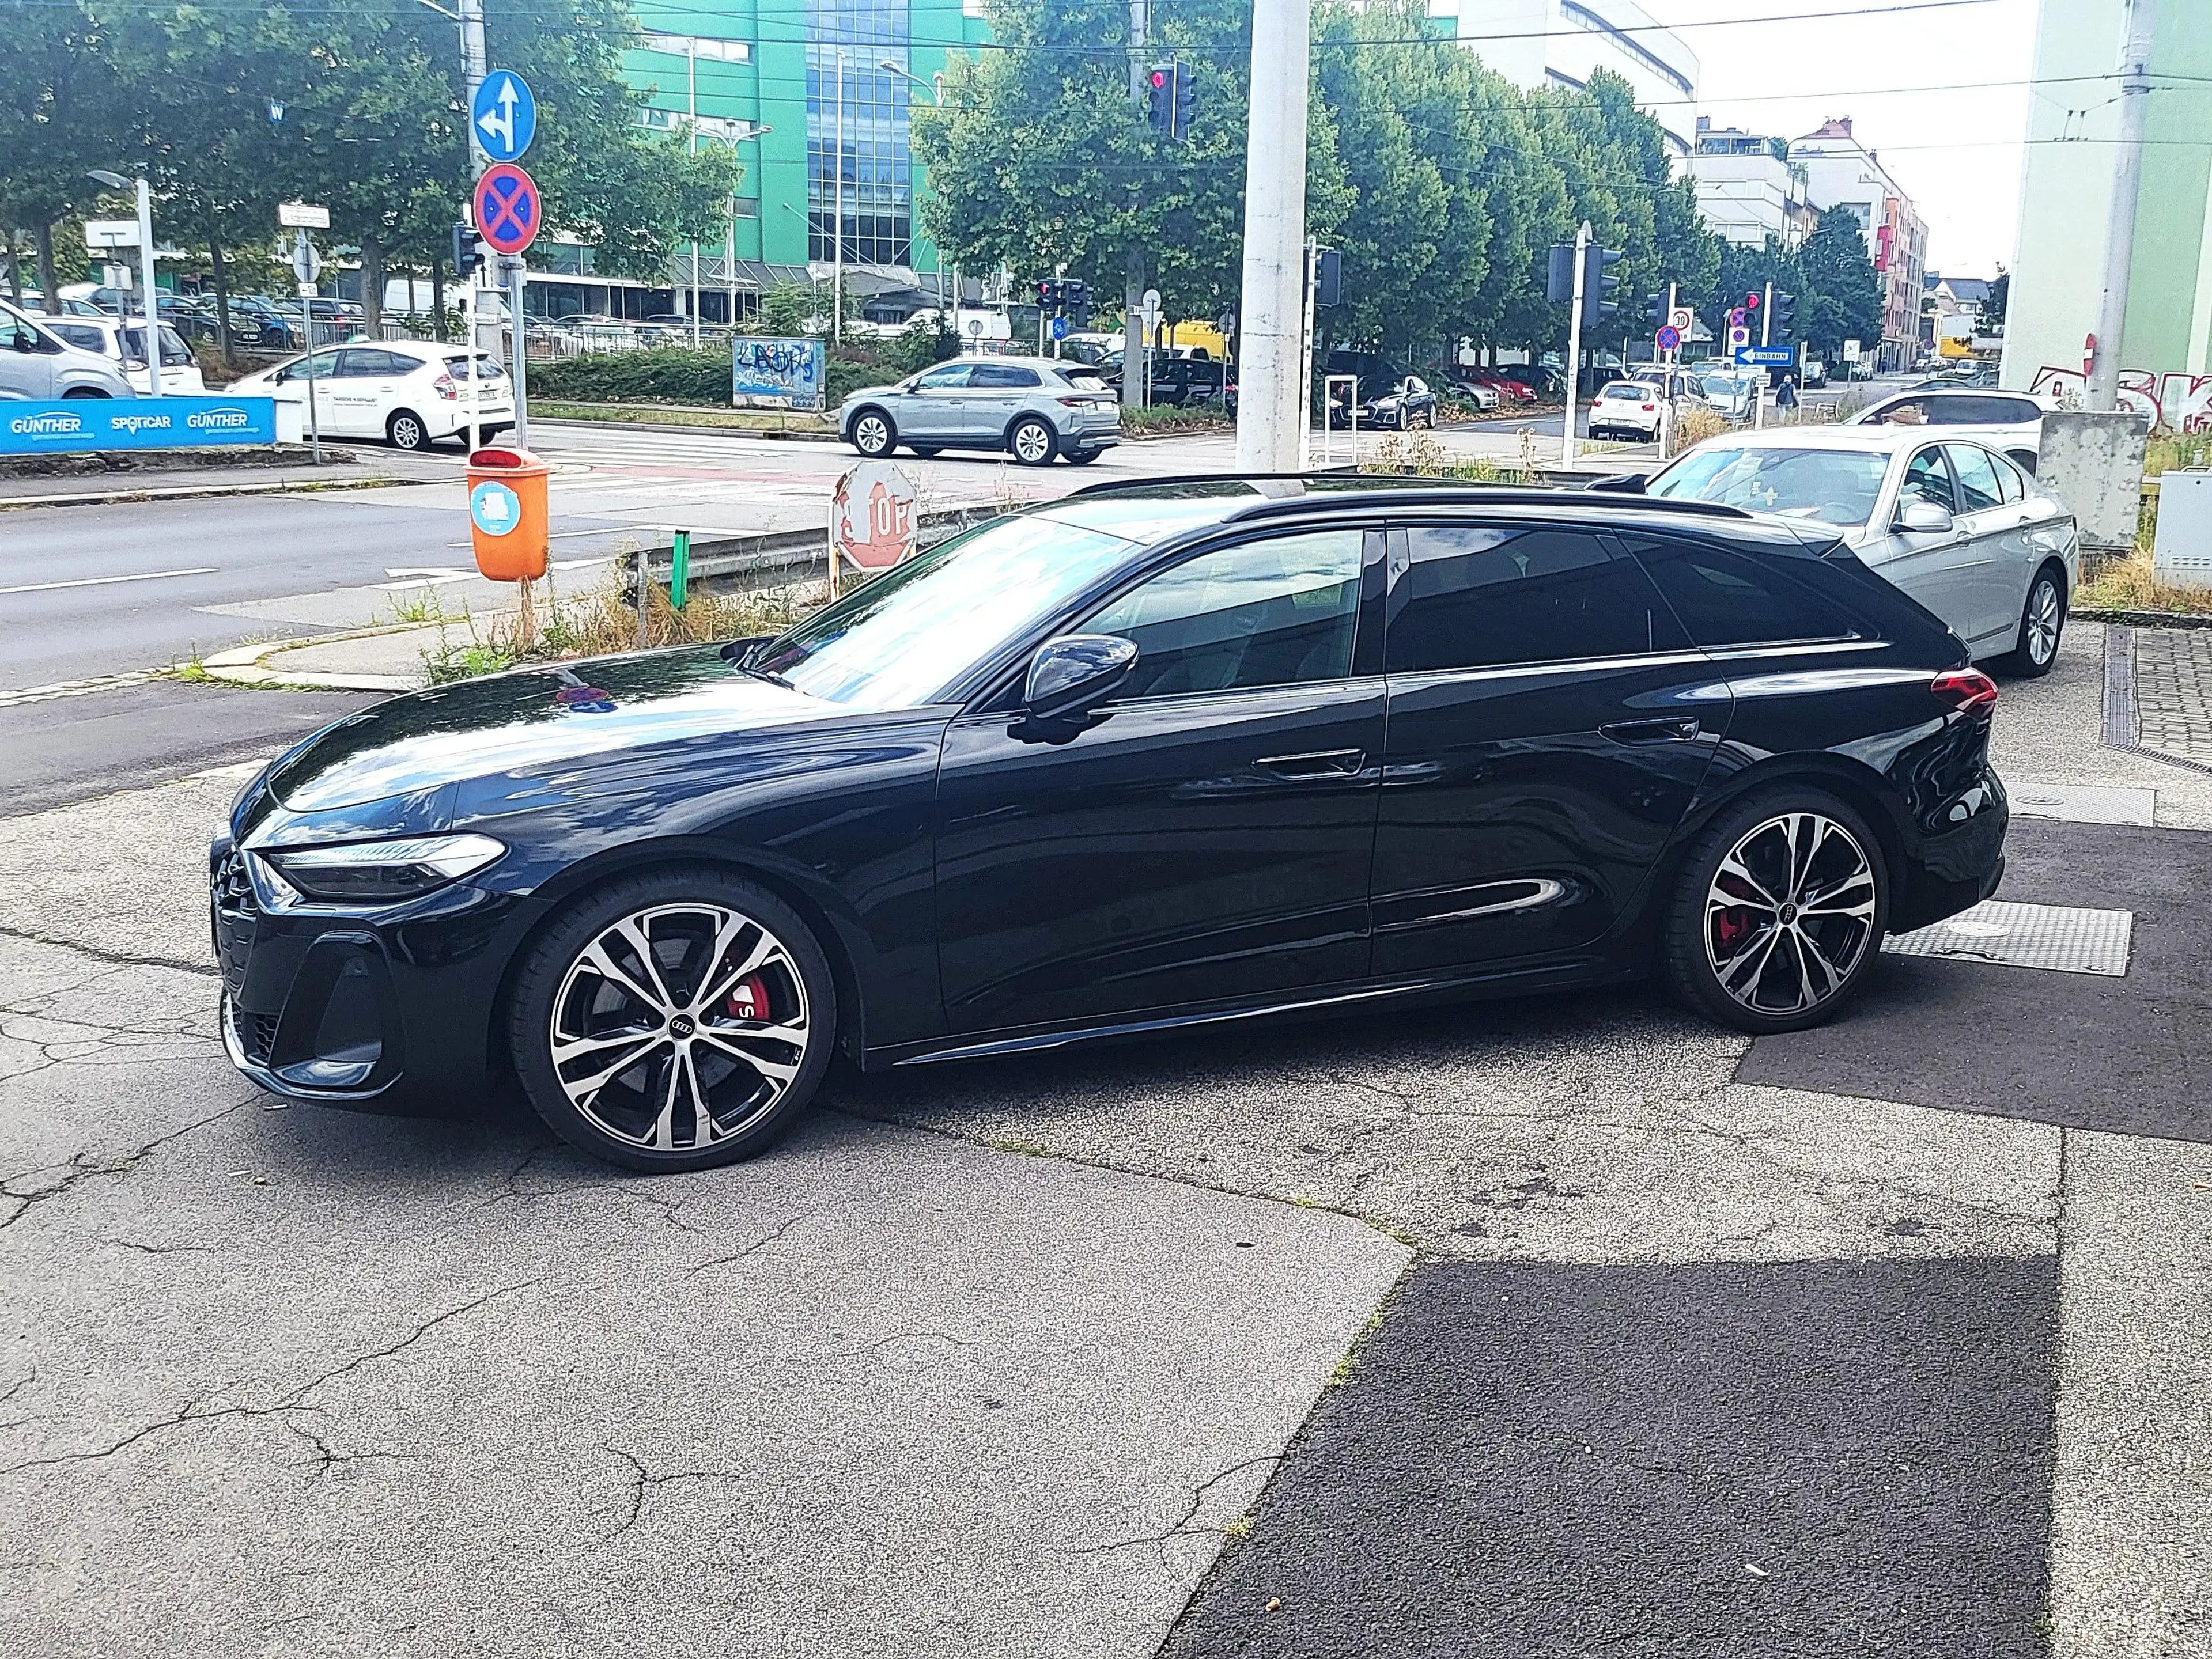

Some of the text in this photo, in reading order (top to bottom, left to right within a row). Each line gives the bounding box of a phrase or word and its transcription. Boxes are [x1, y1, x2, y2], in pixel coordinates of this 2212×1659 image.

[1676, 316, 1685, 326] 30
[12, 416, 81, 433] GÜNTHER
[187, 411, 248, 427] GÜNTHER
[739, 1005, 755, 1018] S
